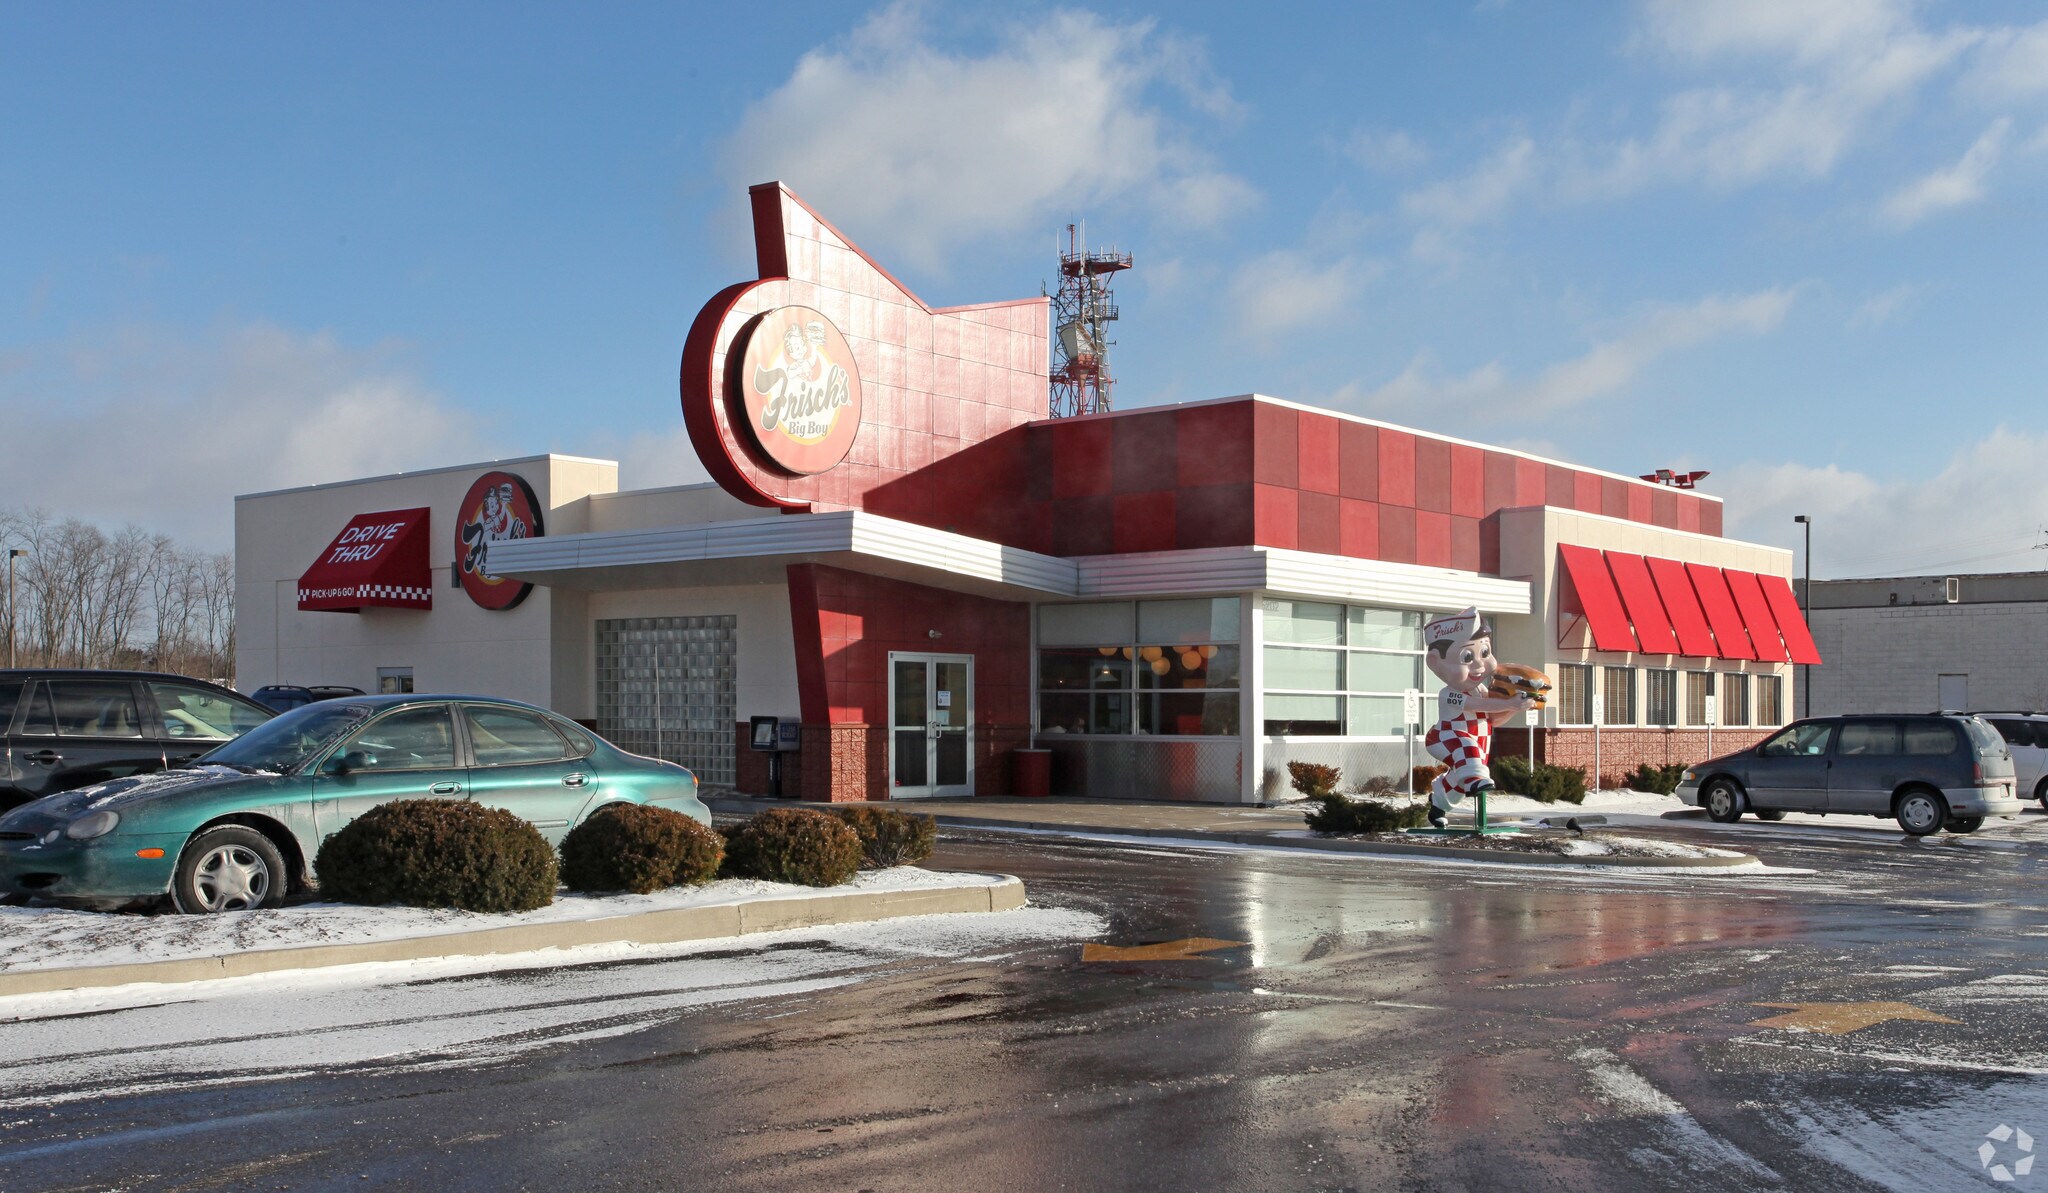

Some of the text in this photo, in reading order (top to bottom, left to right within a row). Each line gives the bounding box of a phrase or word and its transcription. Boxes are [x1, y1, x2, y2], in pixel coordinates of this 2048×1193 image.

[754, 364, 849, 429] Frisch's
[788, 421, 829, 437] Big Boy
[338, 522, 406, 544] DRIVE
[327, 543, 385, 564] THRU
[1446, 698, 1463, 706] BOY
